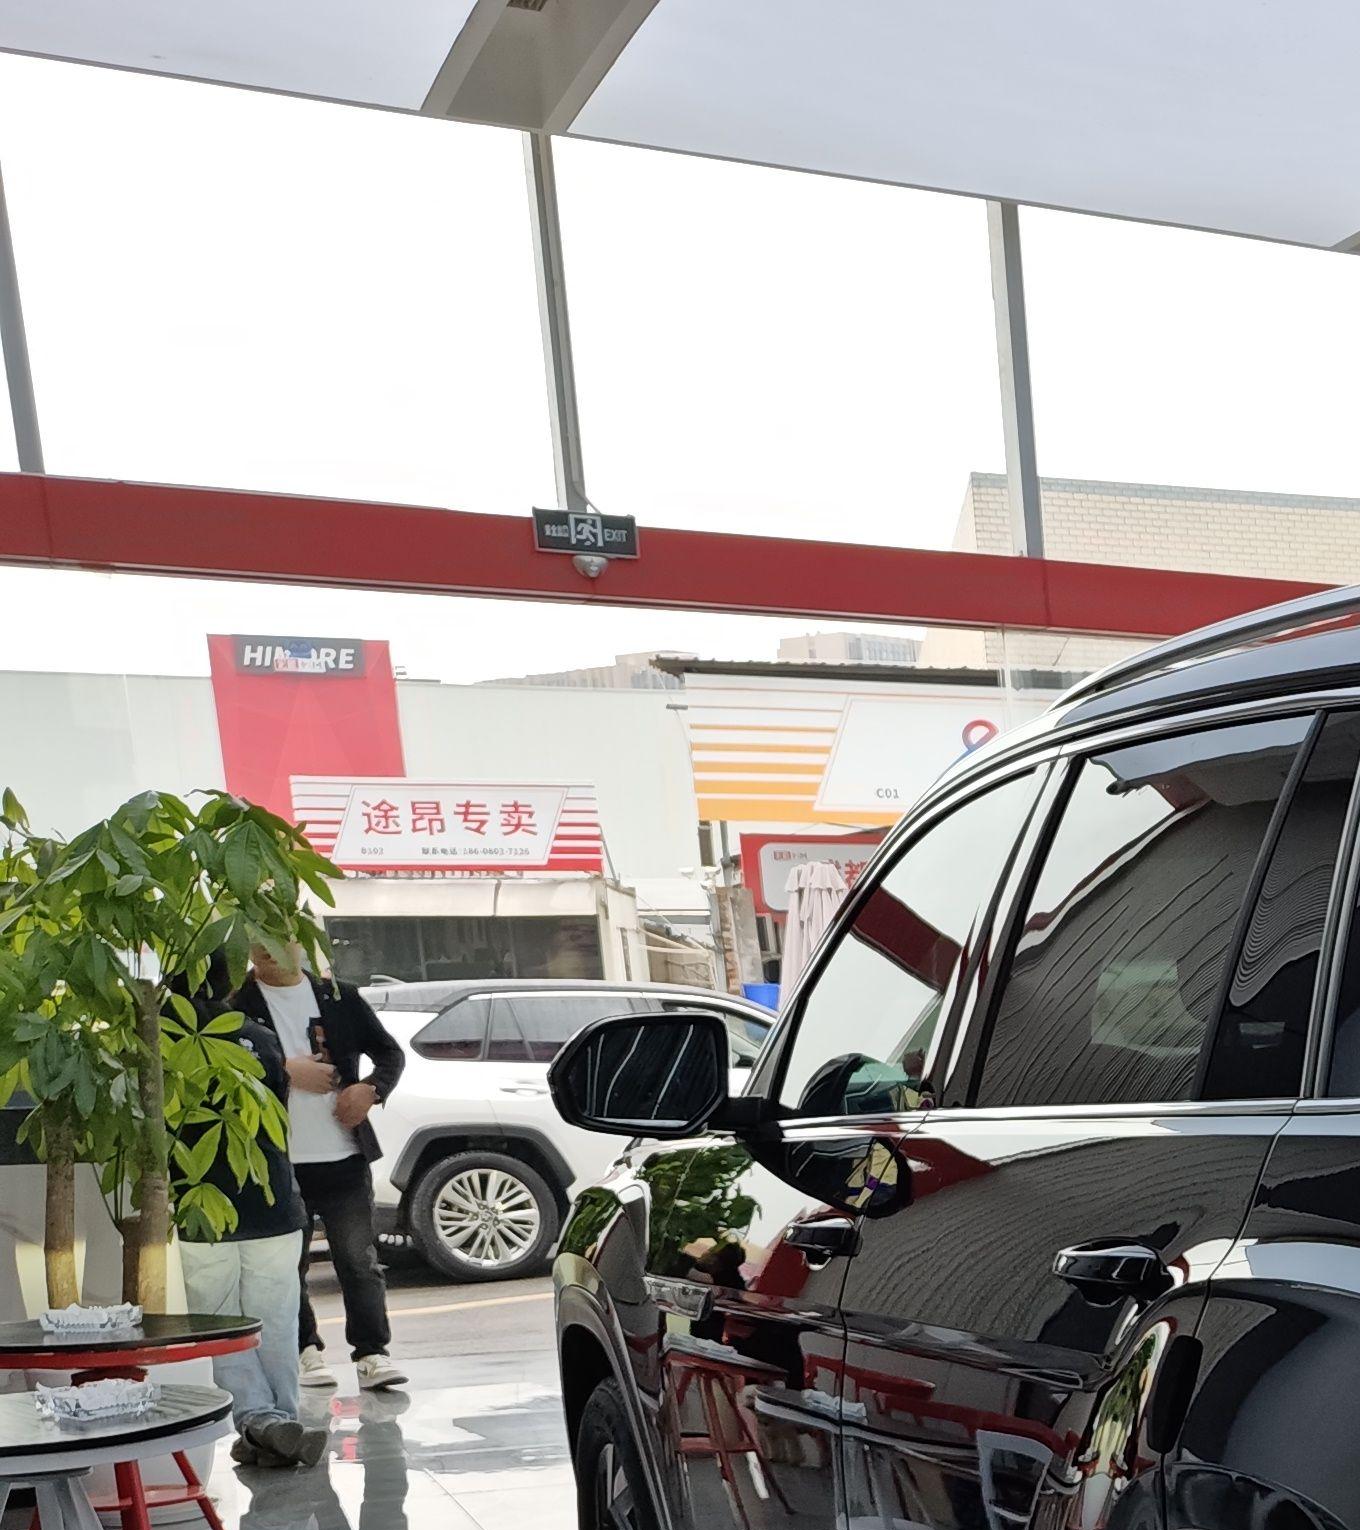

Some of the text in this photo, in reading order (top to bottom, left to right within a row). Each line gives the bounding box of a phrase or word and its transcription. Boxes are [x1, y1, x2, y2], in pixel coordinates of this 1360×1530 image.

[604, 528, 628, 543] EXIT
[243, 645, 354, 669] HIMRE
[876, 788, 899, 799] C01
[361, 799, 538, 836] 途昂专卖
